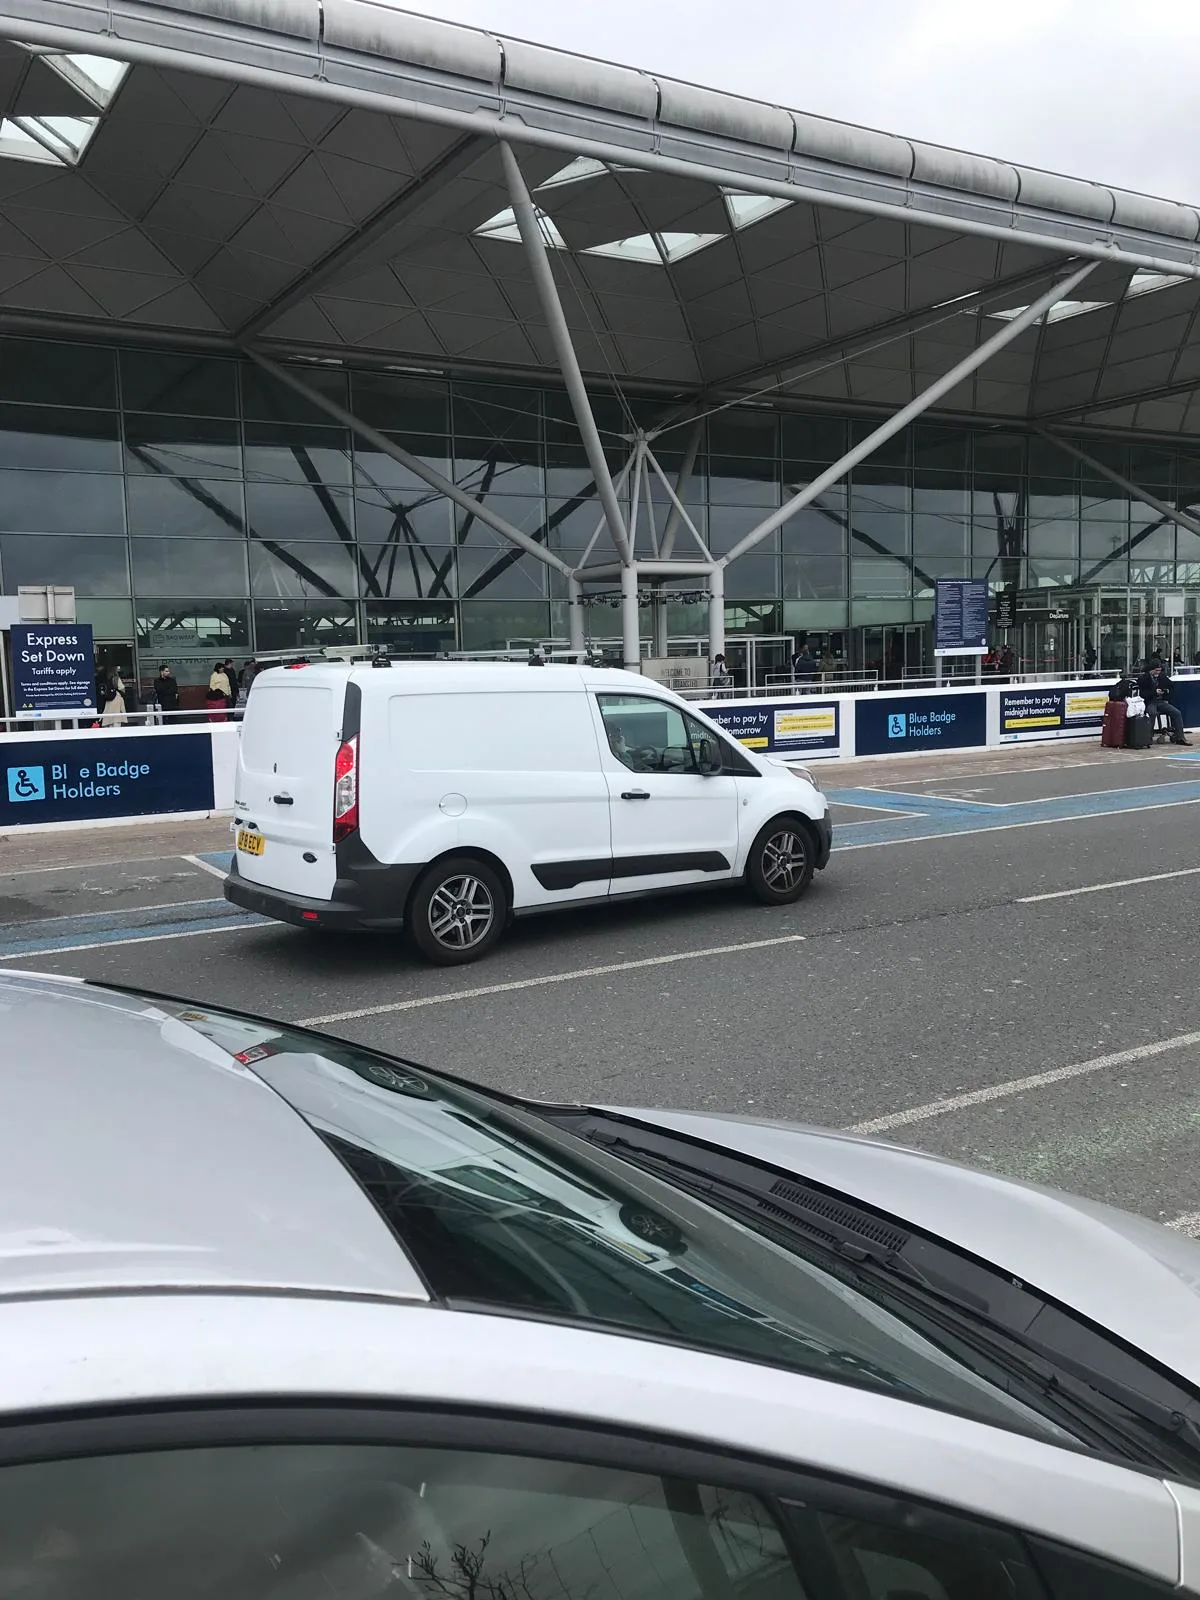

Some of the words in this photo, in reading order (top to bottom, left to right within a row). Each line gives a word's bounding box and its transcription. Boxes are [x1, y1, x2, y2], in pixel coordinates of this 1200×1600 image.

[27, 633, 78, 649] Express
[21, 650, 43, 663] Set
[46, 650, 85, 662] Down
[32, 667, 54, 675] Tariffs
[55, 666, 77, 676] apply
[1004, 695, 1034, 706] Remember
[1041, 697, 1053, 706] pay
[1053, 695, 1061, 704] by
[909, 712, 928, 724] Blue
[929, 710, 956, 724] Badge
[1004, 706, 1029, 717] midnight
[1029, 707, 1056, 715] tomorrow
[733, 715, 741, 724] to
[742, 715, 757, 726] pay
[758, 712, 769, 724] by
[909, 725, 942, 737] Holders
[96, 760, 150, 779] Badge
[53, 781, 121, 799] Holders
